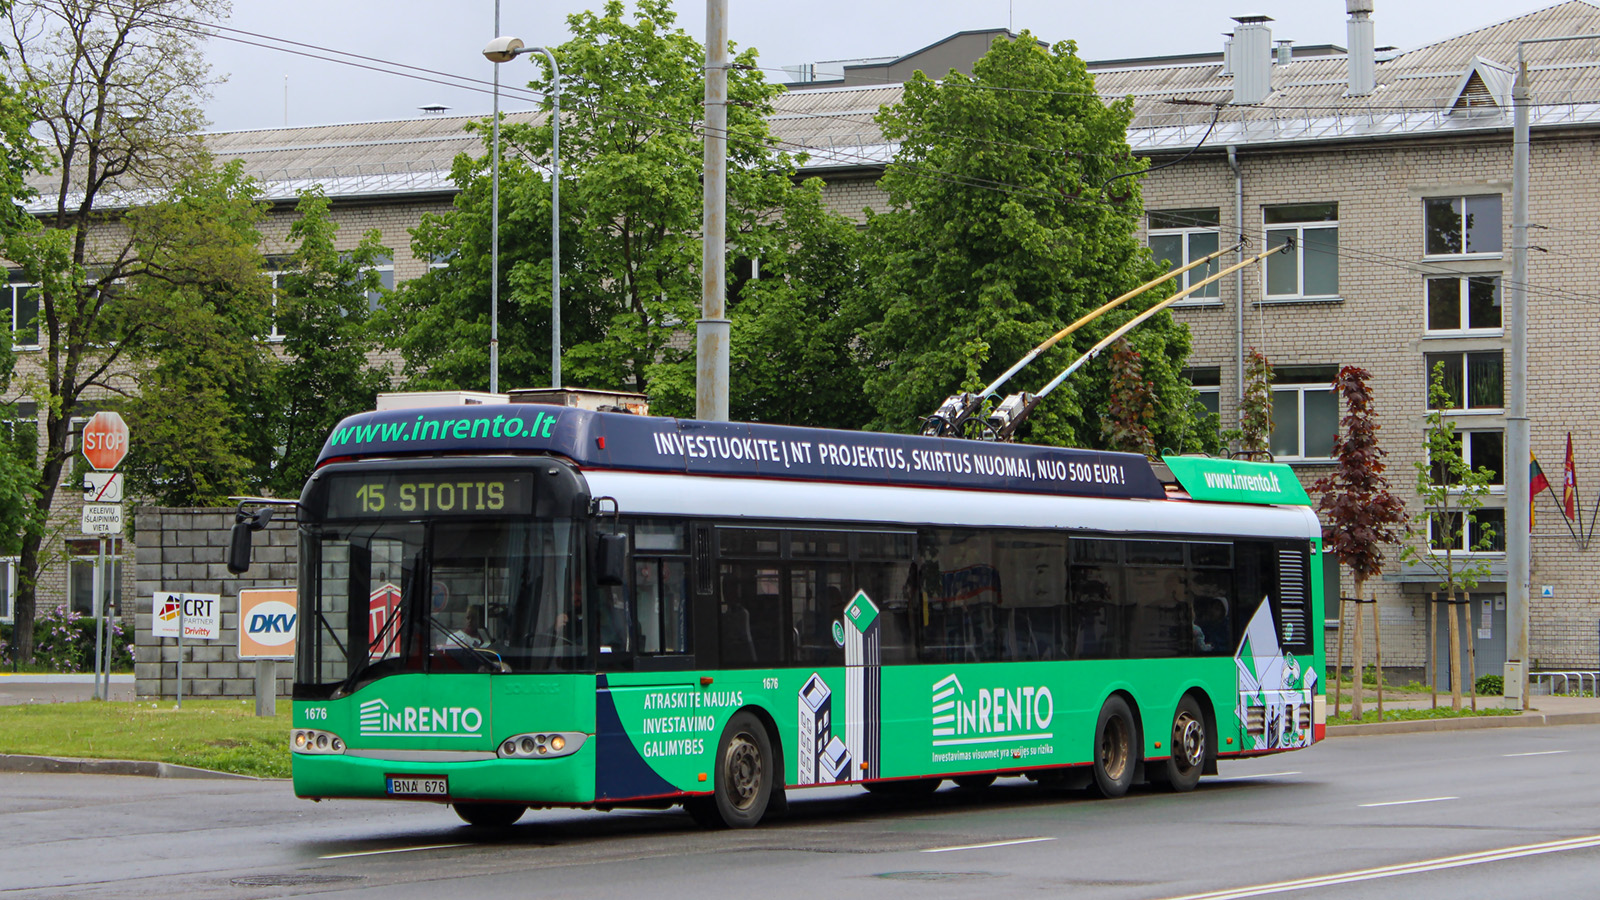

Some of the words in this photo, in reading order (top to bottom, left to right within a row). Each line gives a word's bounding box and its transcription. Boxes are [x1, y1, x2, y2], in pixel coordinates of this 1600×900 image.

[331, 412, 556, 446] www.inrento.lt
[86, 432, 125, 450] STOP
[653, 433, 780, 462] INVESTUOKITE
[791, 442, 811, 464] NT
[819, 443, 910, 472] PROJEKTUS,
[911, 450, 972, 474] SKIRTUS
[973, 454, 1036, 482] NUOMAI,
[1036, 459, 1066, 481] NUO
[1069, 462, 1092, 482] 500
[1204, 469, 1281, 493] www.inrento.lt
[356, 484, 385, 512] 15
[400, 482, 505, 511] STOTIS
[84, 514, 120, 523] IŠLAIPINIMO
[184, 599, 214, 617] CRT
[183, 617, 214, 625] PARTNER
[249, 614, 296, 633] DKV
[184, 626, 211, 637] Drivitty
[763, 677, 779, 689] 1676
[643, 692, 701, 710] ATRASKITE
[703, 690, 744, 707] NAUJAS
[304, 707, 327, 720] 1676
[643, 715, 715, 734] INVESTAVIMO
[932, 750, 972, 763] Investavimas
[972, 748, 1000, 760] visuomet
[1000, 748, 1010, 760] yra
[1030, 746, 1037, 755] su
[1037, 743, 1054, 755] rizika
[393, 781, 418, 793] BNA
[425, 781, 445, 793] 676
